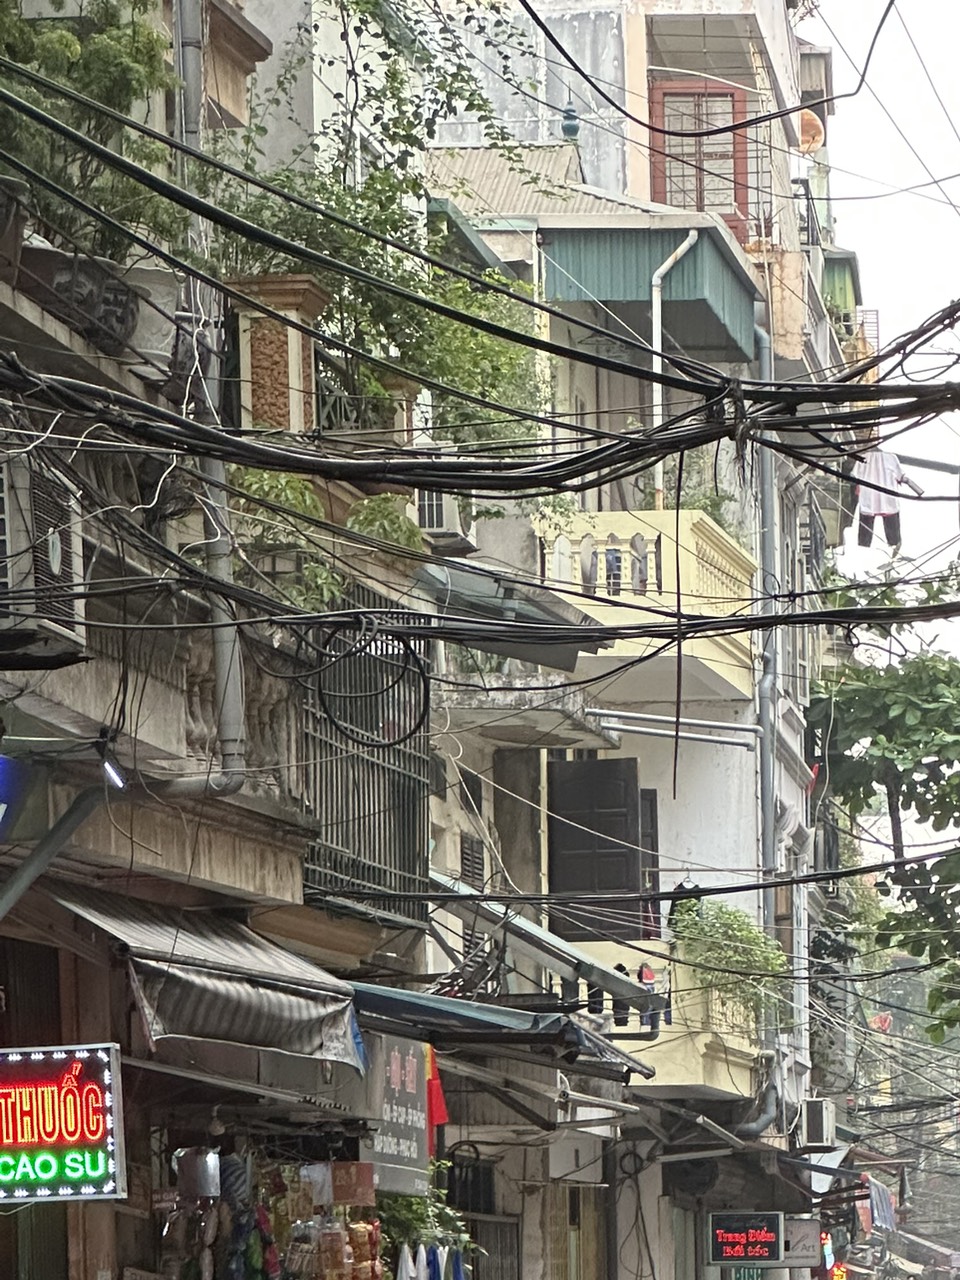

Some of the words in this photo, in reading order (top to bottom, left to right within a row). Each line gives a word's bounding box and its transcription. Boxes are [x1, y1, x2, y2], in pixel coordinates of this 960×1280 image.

[0, 1061, 104, 1143] THUỐC
[0, 1152, 58, 1181] CAO
[64, 1150, 106, 1179] SU
[716, 1229, 747, 1244] Trang
[801, 1244, 816, 1253] Art
